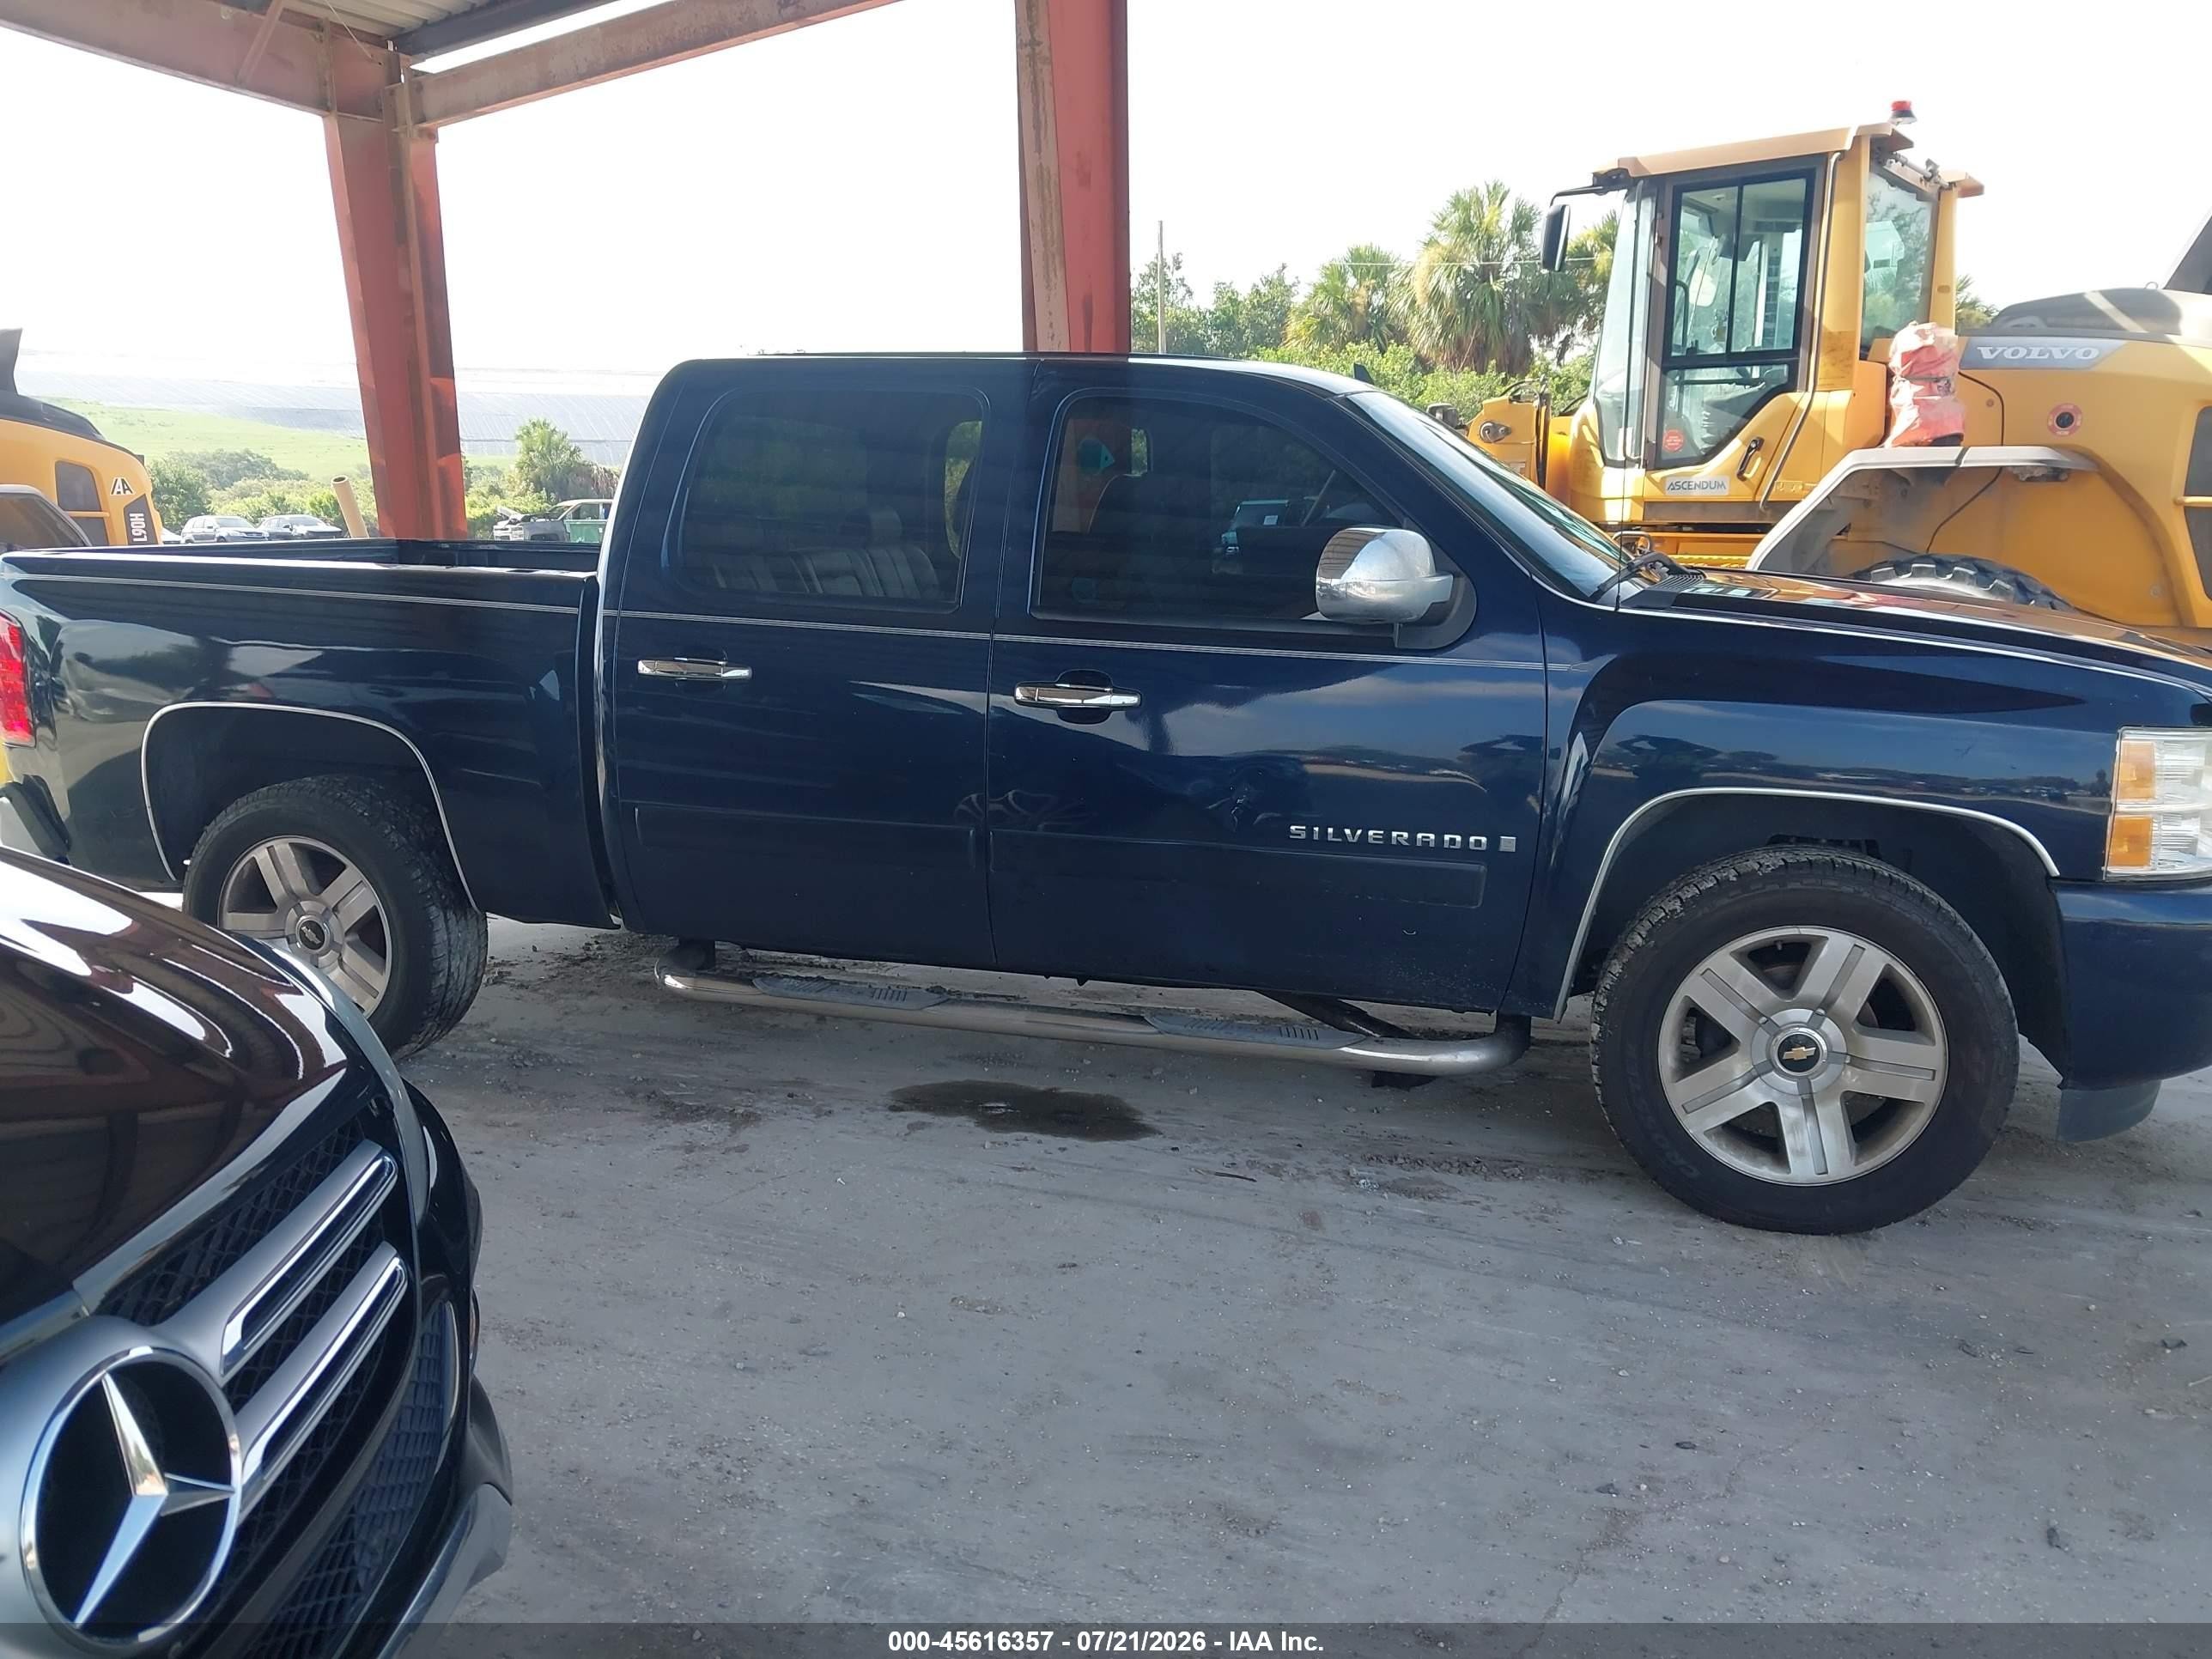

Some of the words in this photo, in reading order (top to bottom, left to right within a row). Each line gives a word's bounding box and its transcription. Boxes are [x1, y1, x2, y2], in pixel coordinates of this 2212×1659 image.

[1977, 346, 2100, 360] VOLVO
[1667, 480, 1727, 491] ASCENDUM
[129, 513, 148, 542] L90H
[1289, 825, 1487, 851] SILVERADO
